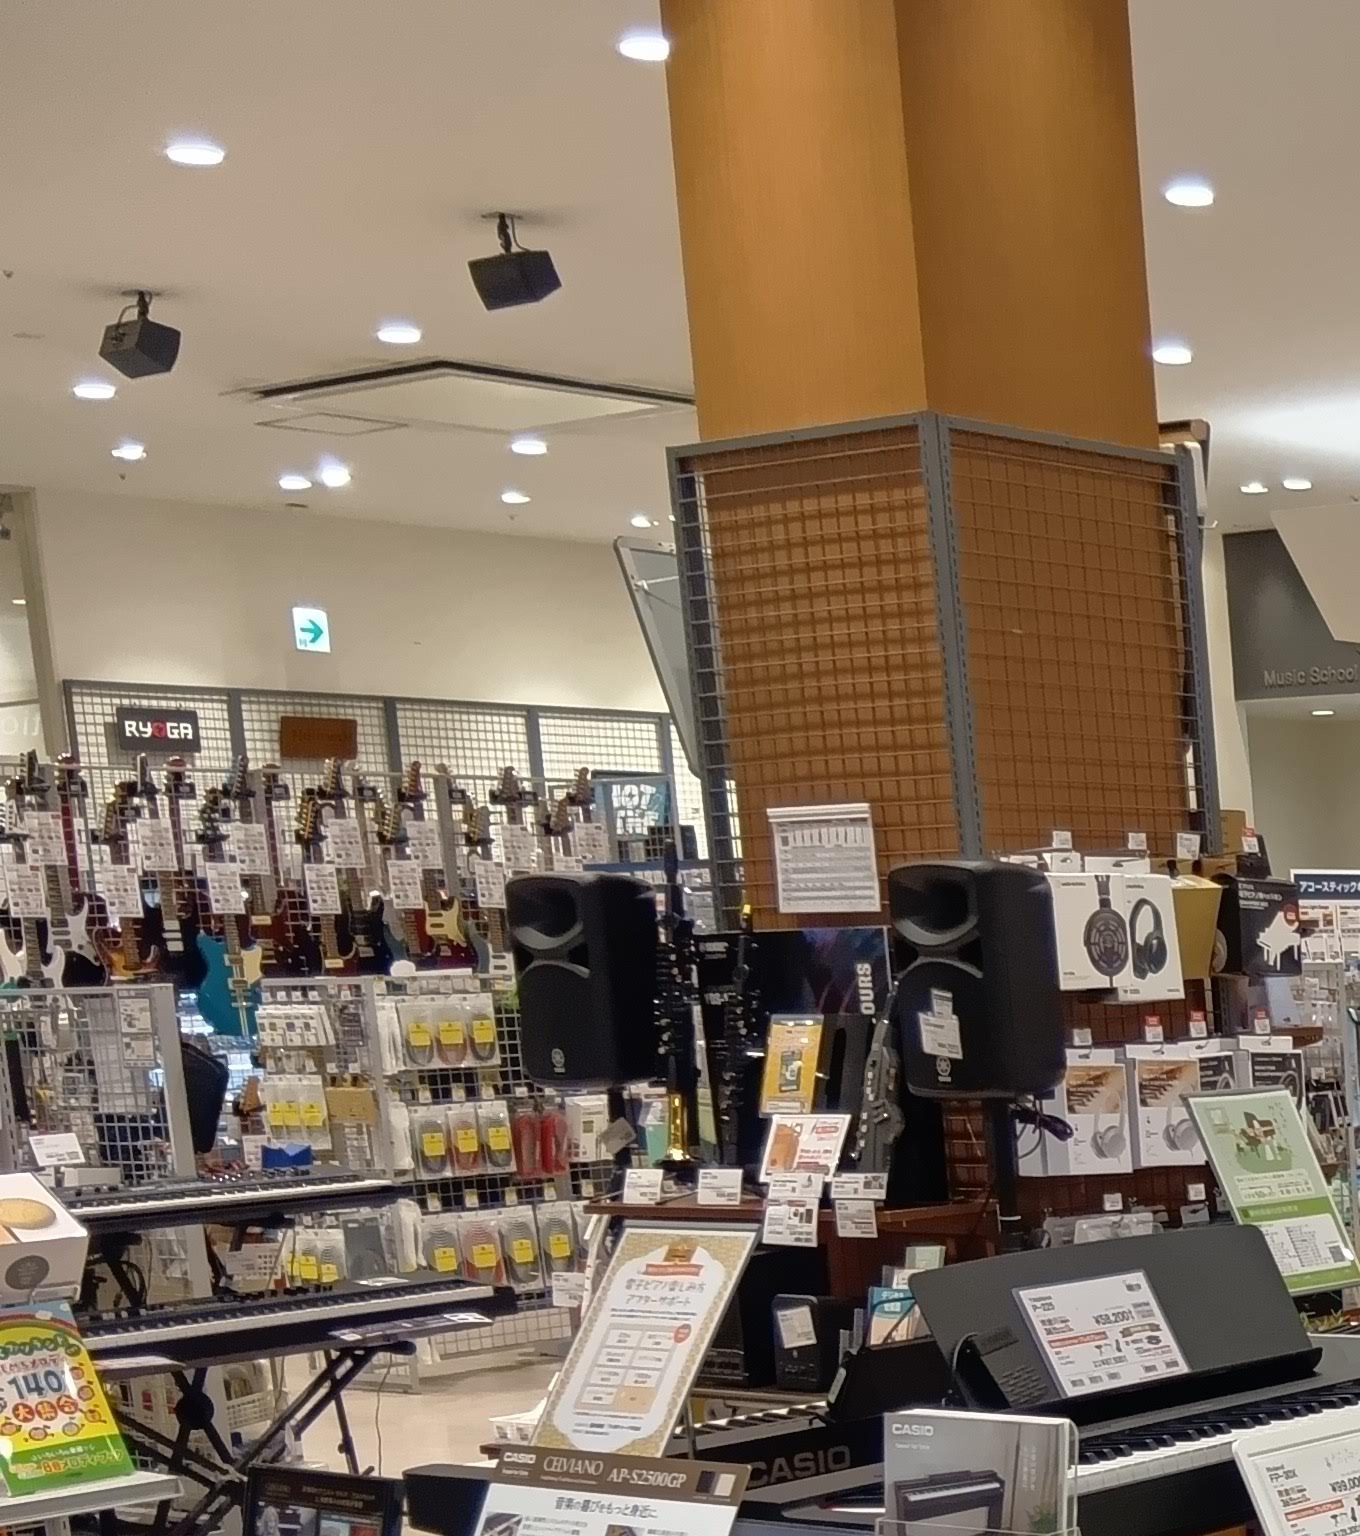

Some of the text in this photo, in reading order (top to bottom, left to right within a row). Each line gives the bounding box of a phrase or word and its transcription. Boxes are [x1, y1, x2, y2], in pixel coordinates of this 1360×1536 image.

[1264, 669, 1306, 688] Music
[1310, 664, 1358, 685] School
[124, 719, 193, 740] RYOGA
[892, 1423, 934, 1436] CASIO
[503, 1452, 537, 1464] CASIO
[749, 1445, 850, 1488] CASIO
[606, 1467, 687, 1489] AP-S2500GP
